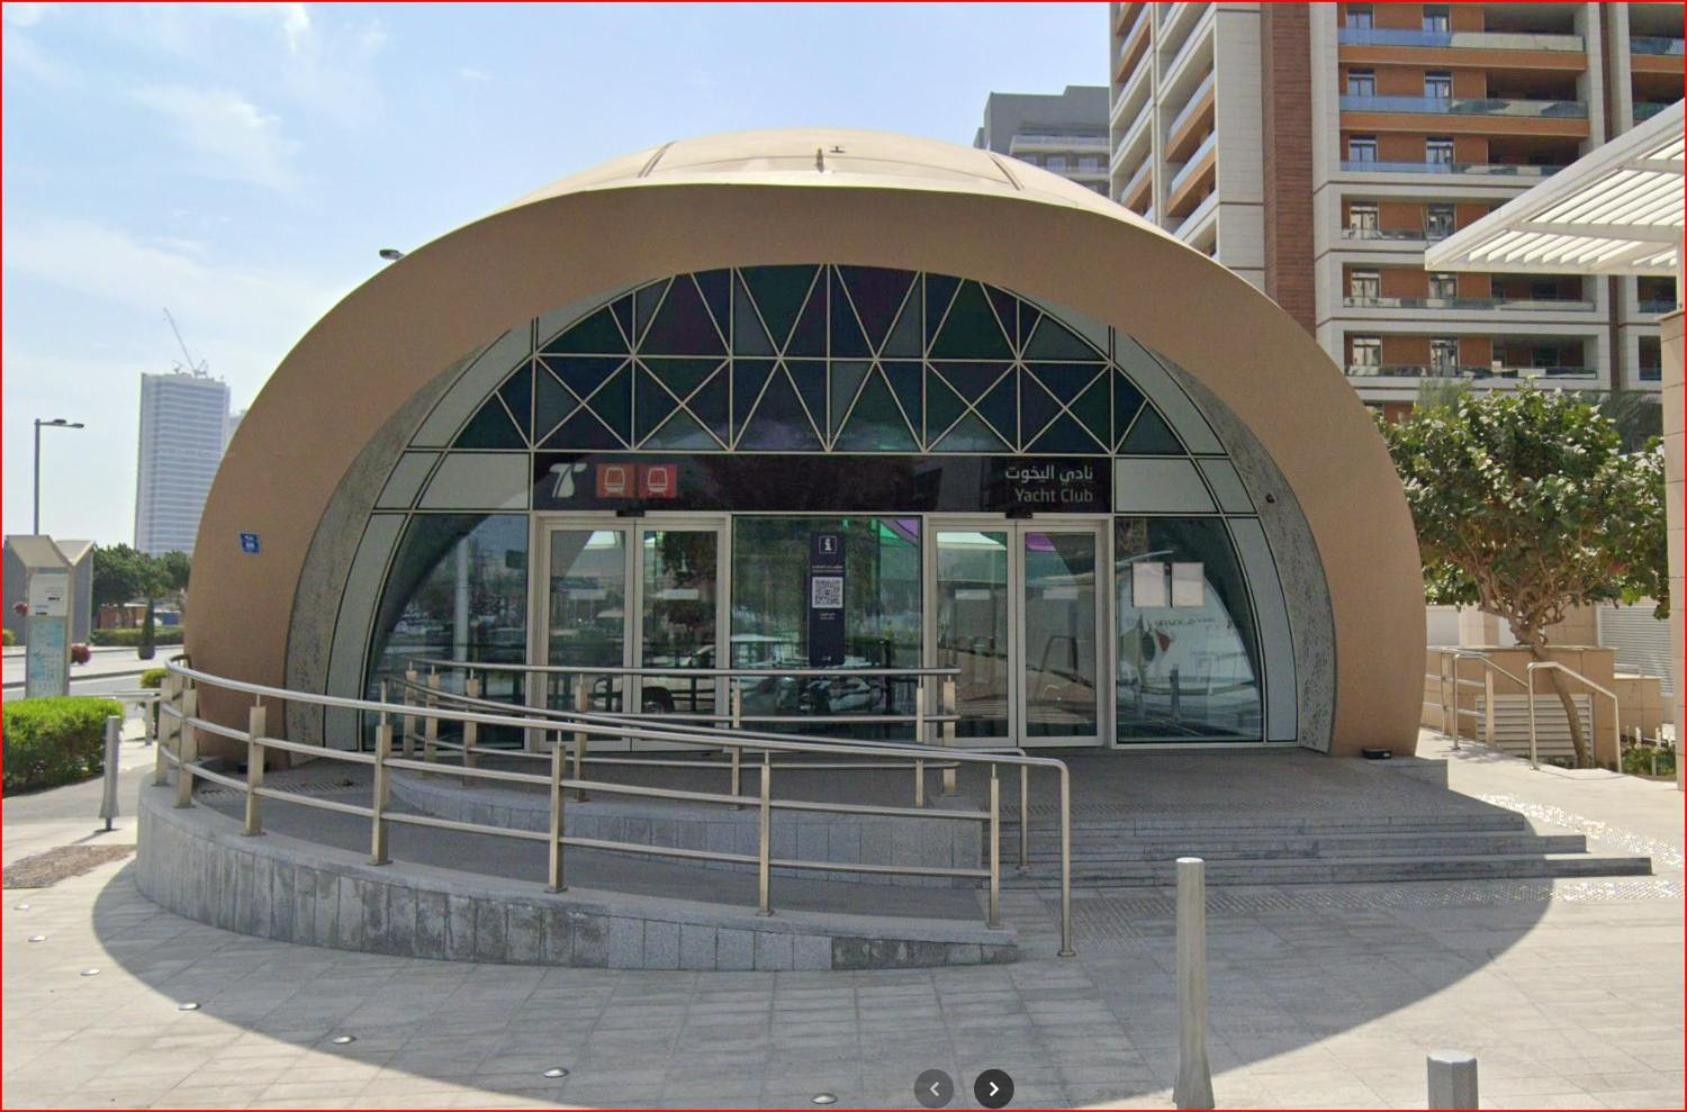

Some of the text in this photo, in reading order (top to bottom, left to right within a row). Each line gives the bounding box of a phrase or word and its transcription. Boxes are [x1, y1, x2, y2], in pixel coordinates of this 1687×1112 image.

[1005, 464, 1093, 485] نادي اليخوت
[1015, 488, 1093, 502] Yacht Club
